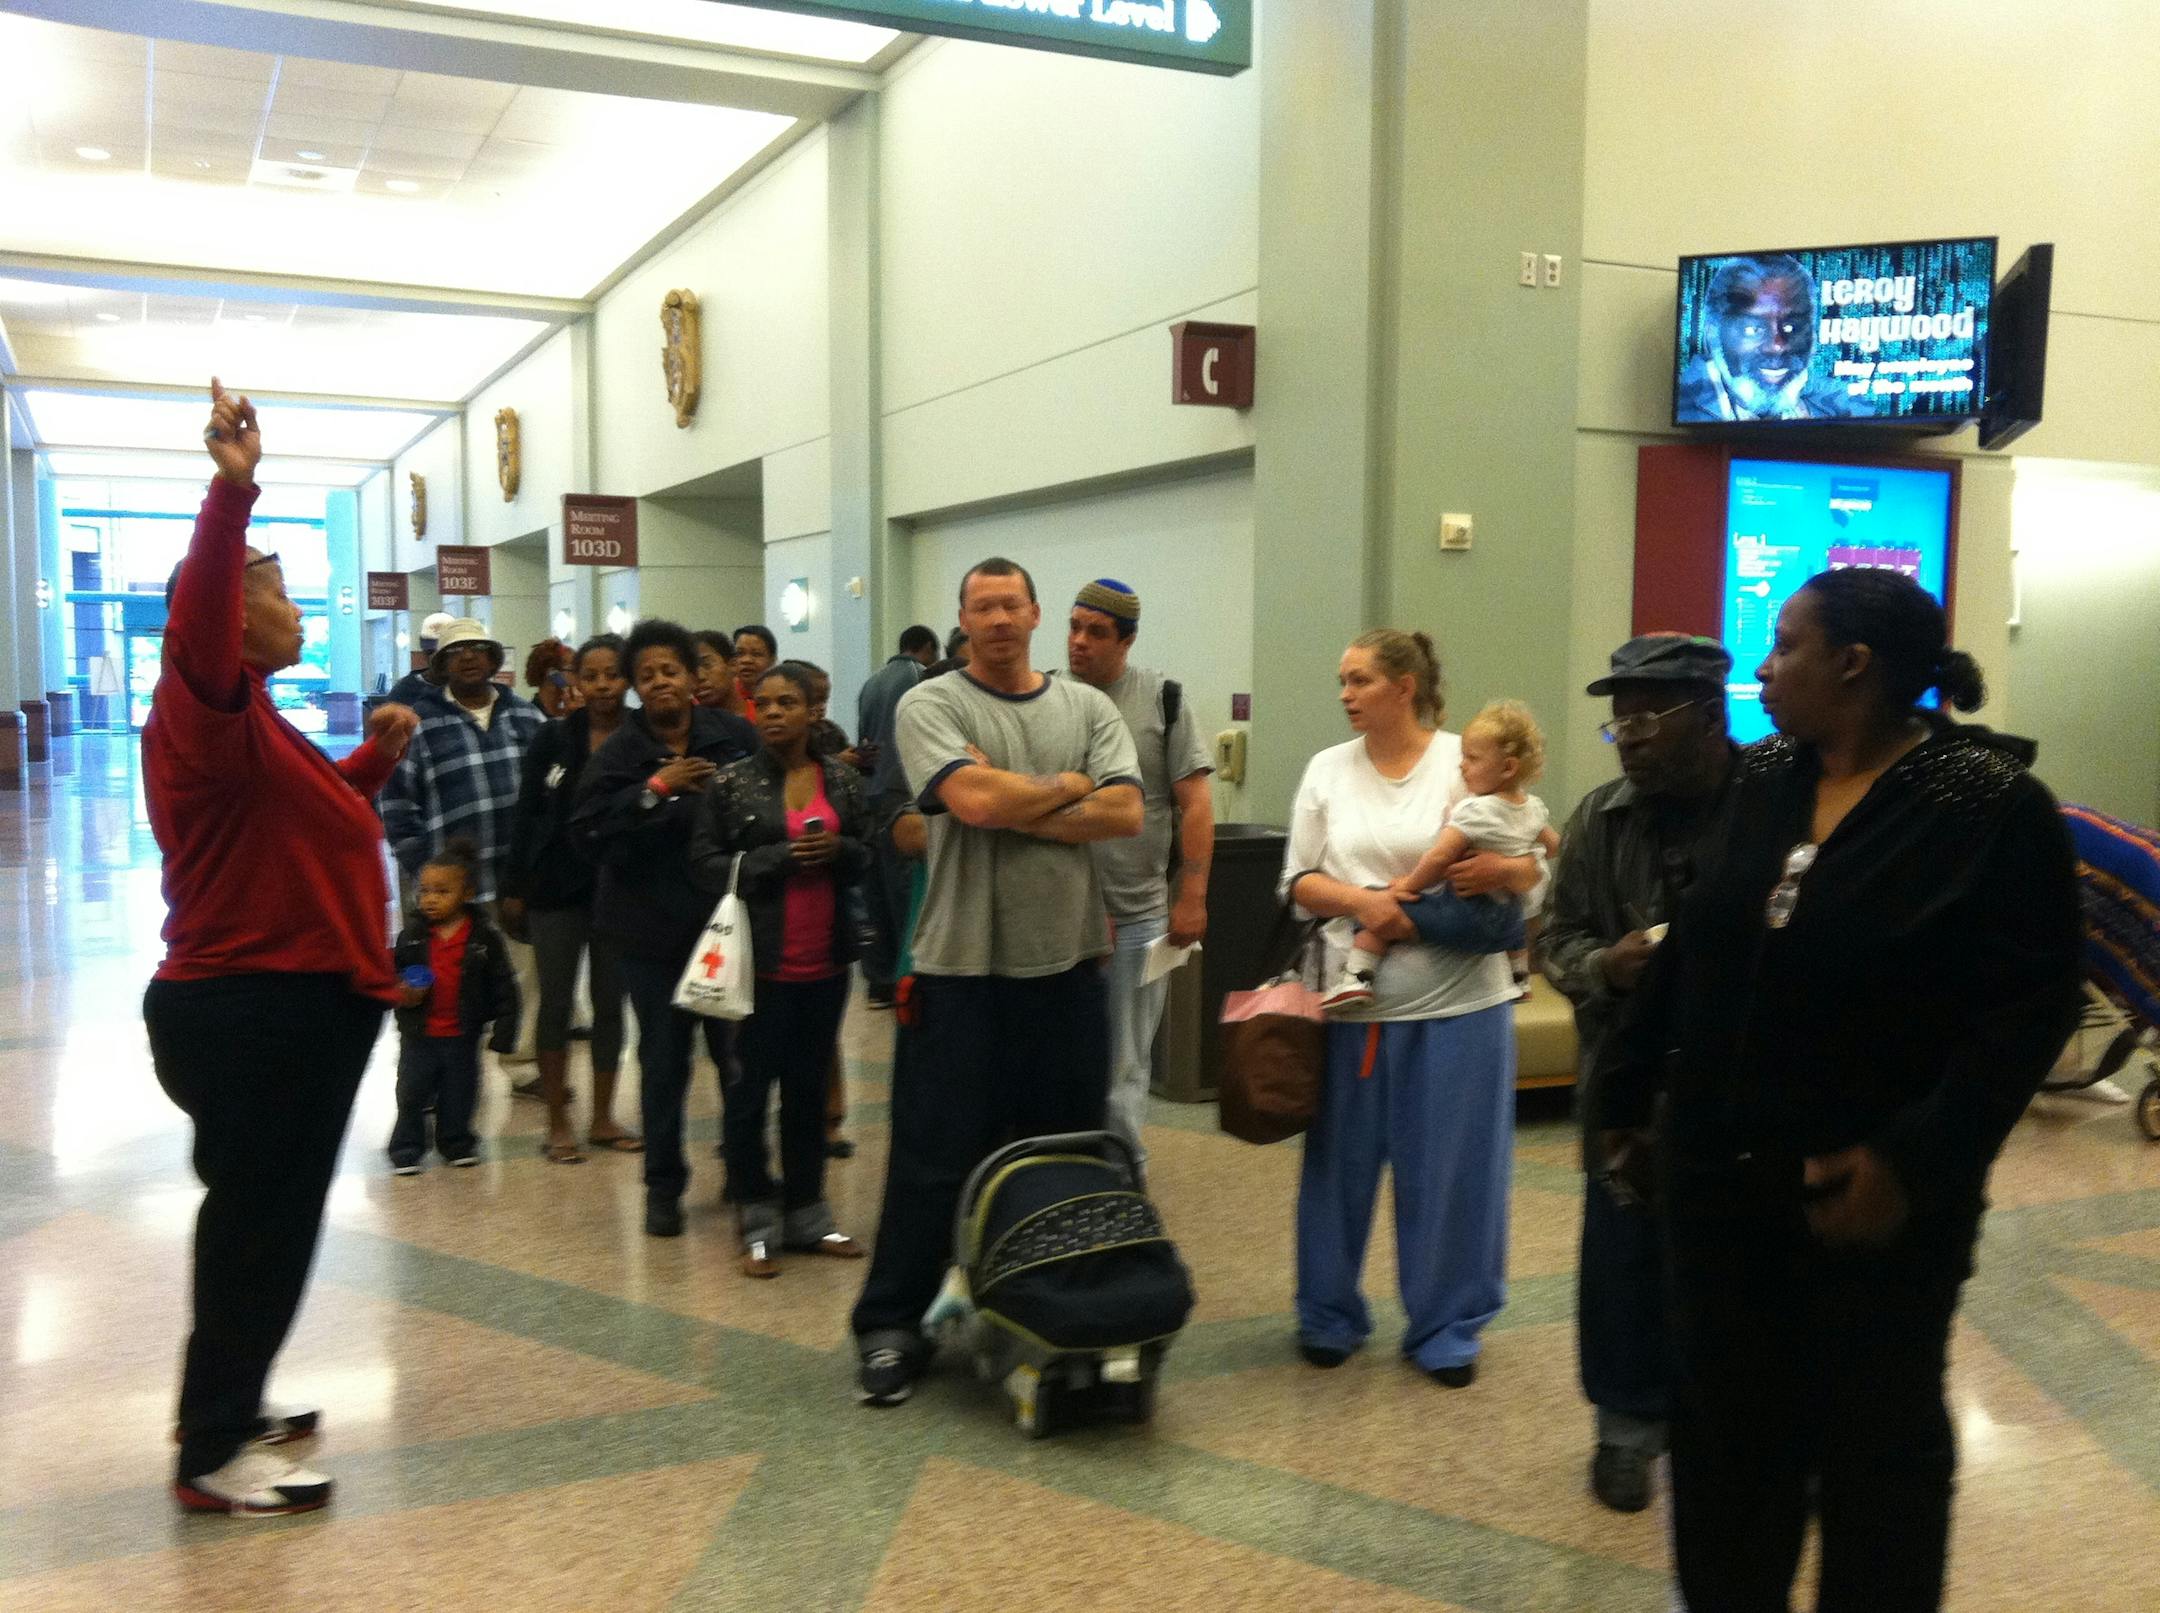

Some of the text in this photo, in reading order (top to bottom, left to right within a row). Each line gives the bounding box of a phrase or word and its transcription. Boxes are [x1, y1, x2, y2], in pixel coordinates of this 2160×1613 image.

[1819, 305, 1975, 353] Haywood
[570, 539, 622, 558] 103D
[441, 576, 479, 590] 103E
